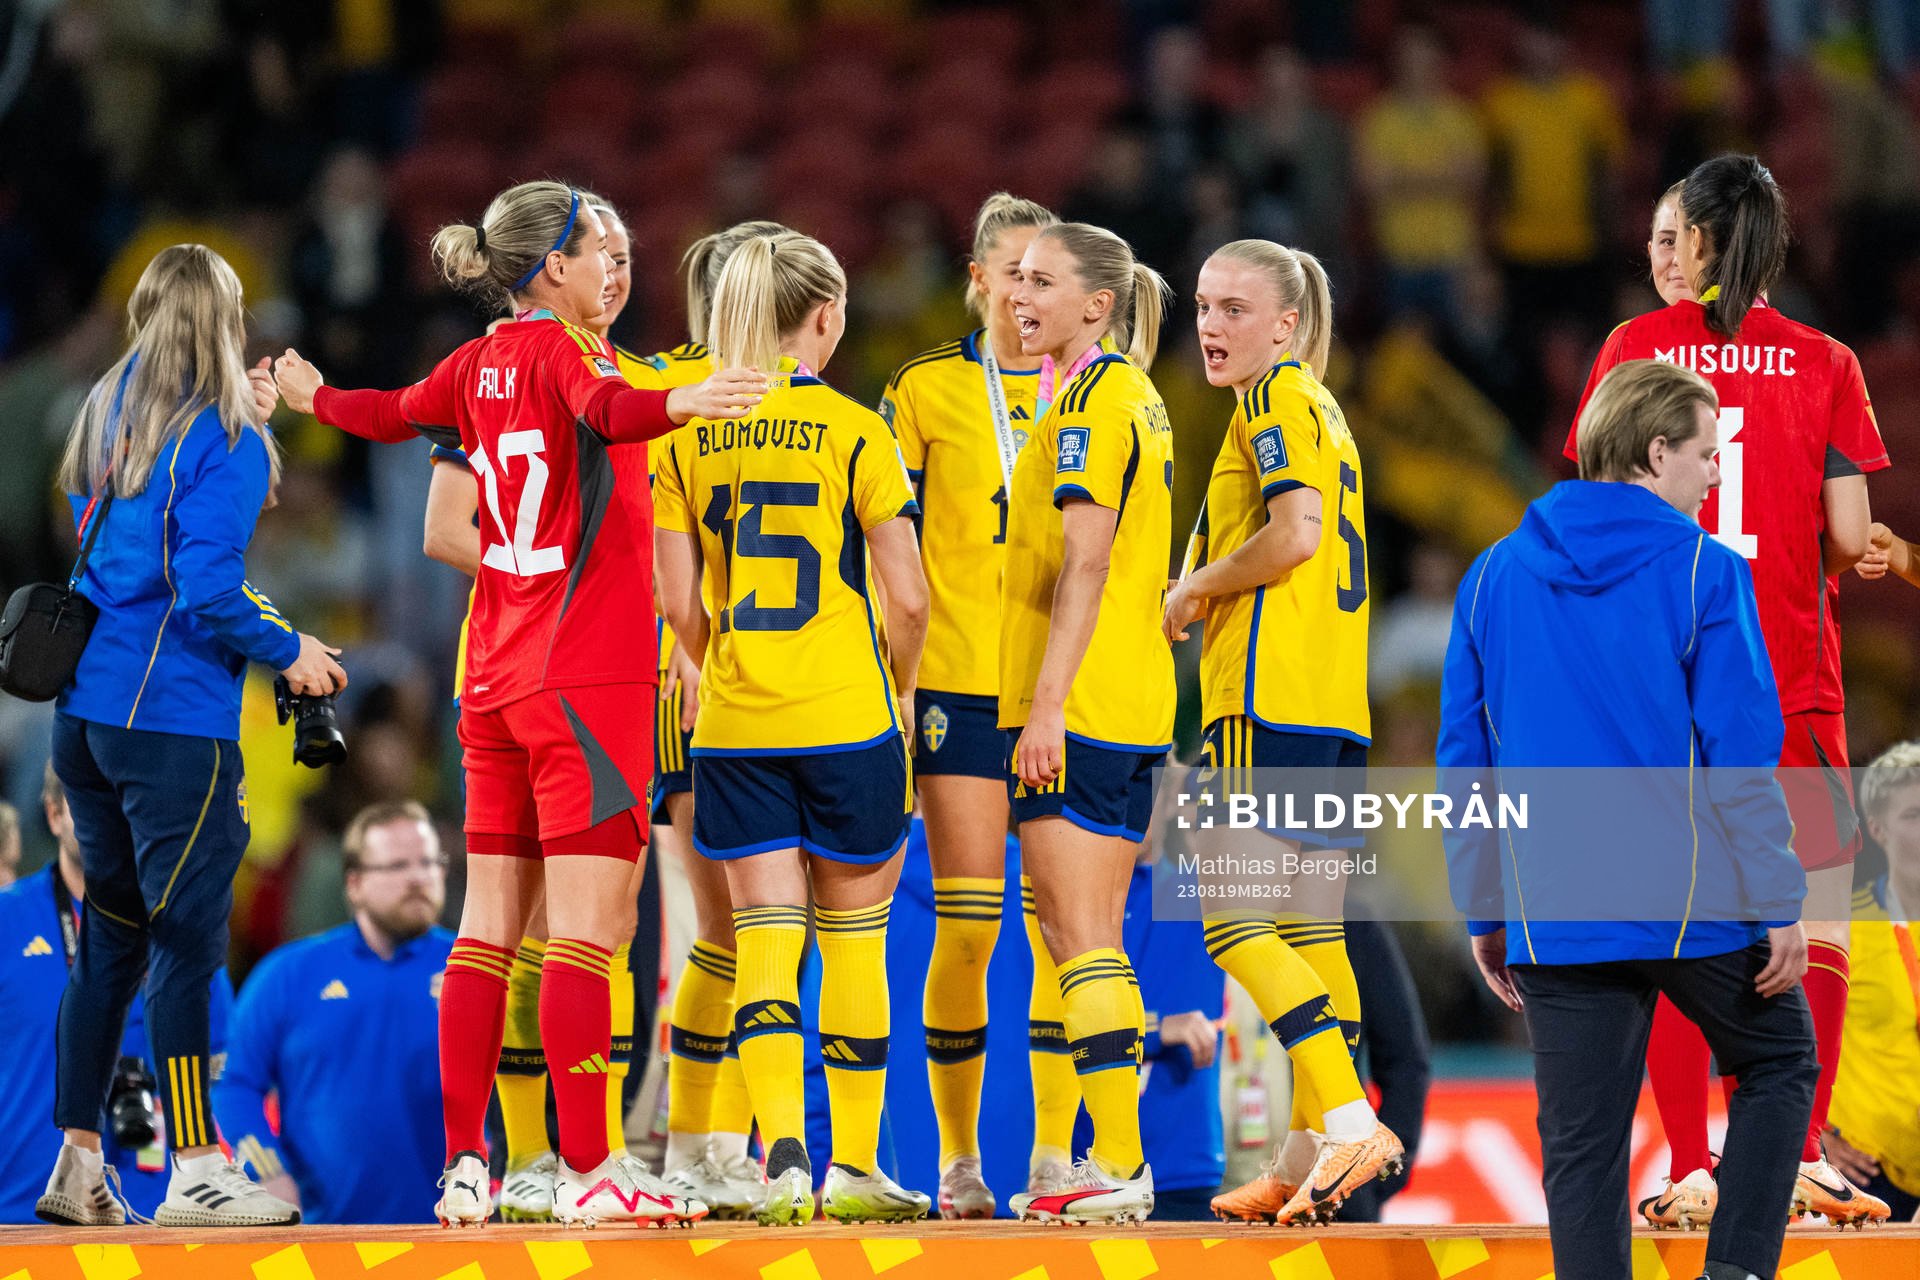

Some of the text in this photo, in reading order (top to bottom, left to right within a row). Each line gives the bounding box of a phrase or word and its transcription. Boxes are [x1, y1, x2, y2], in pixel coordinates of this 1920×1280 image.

[477, 367, 517, 399] FALK
[1655, 344, 1796, 376] MUSOVIC
[697, 418, 828, 457] BLOMQVIST
[996, 408, 1007, 435] WORLD
[468, 429, 567, 577] 12
[1709, 407, 1758, 559] 1
[702, 481, 821, 634] 15
[1336, 460, 1367, 613] 5
